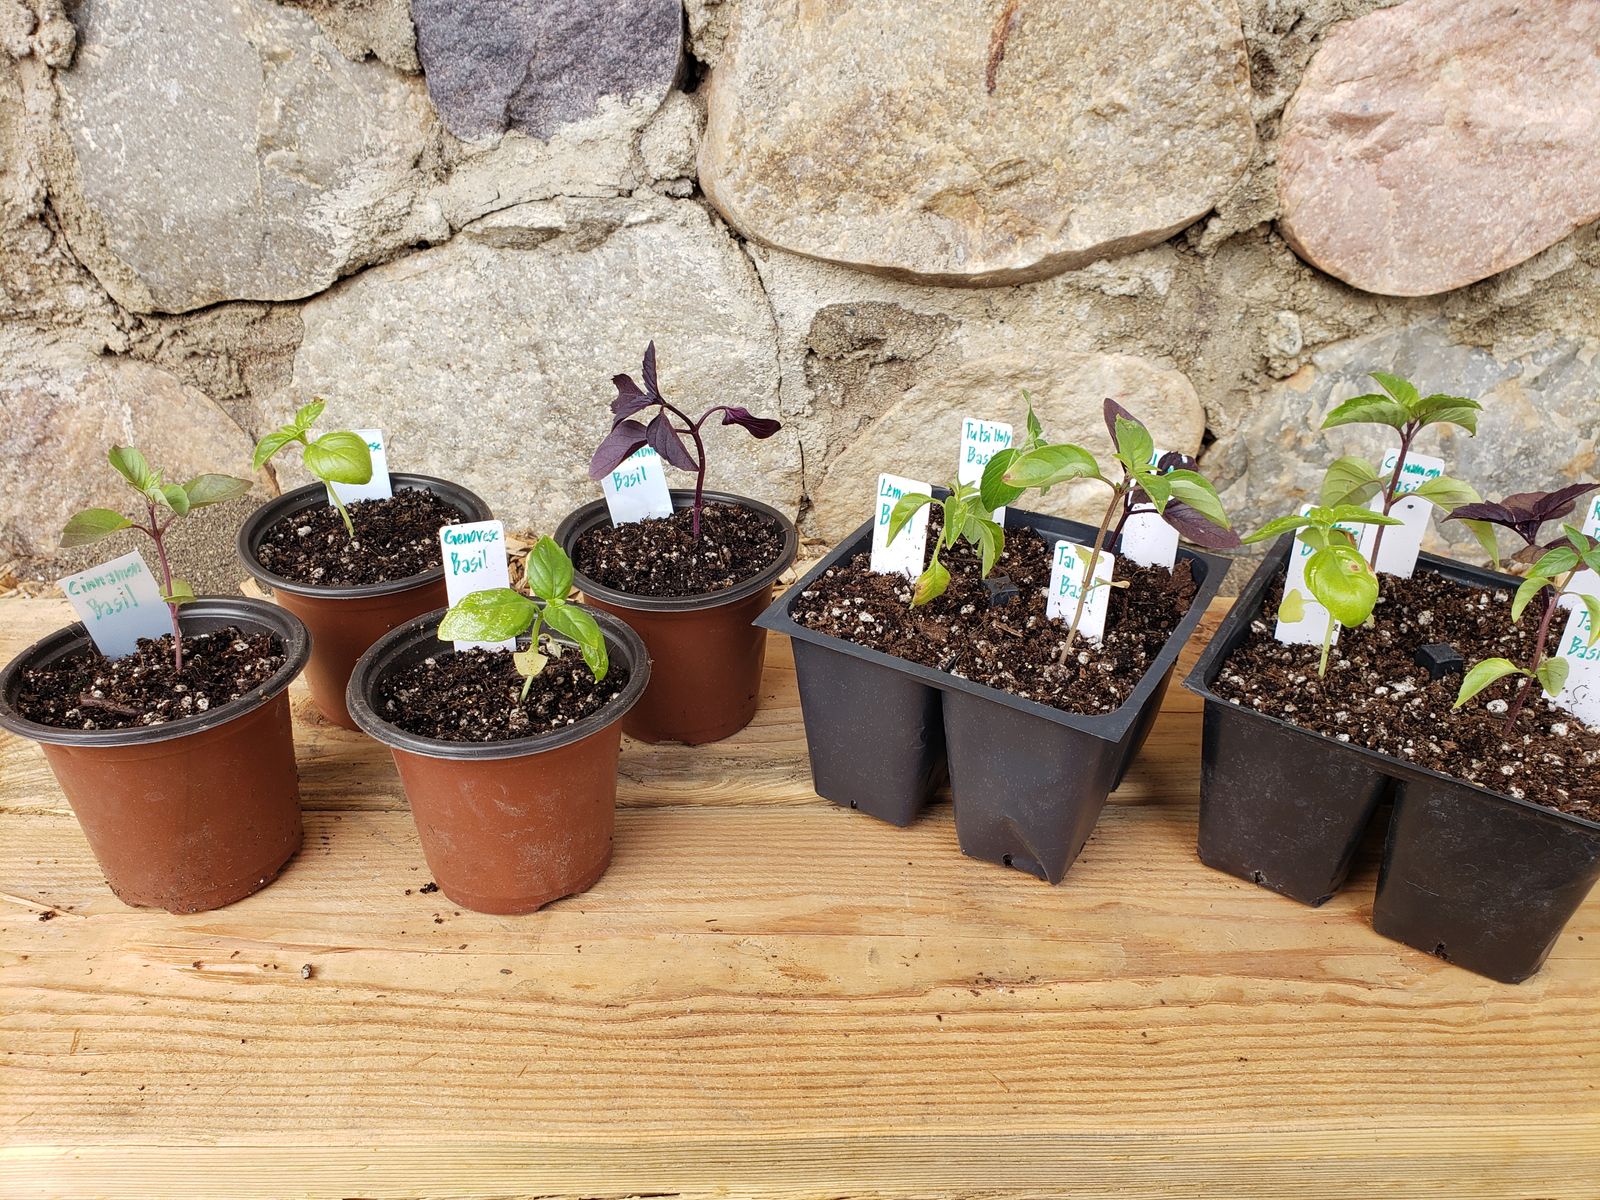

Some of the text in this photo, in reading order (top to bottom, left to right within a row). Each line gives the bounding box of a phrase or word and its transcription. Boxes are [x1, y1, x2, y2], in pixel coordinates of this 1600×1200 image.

[994, 428, 1011, 448] Holy
[967, 445, 998, 466] Bas
[613, 465, 647, 492] Basil
[880, 478, 911, 500] Lem
[444, 529, 499, 545] Genovese
[451, 548, 488, 576] Basil
[68, 562, 142, 596] Cinnamon
[86, 583, 139, 620] Basil
